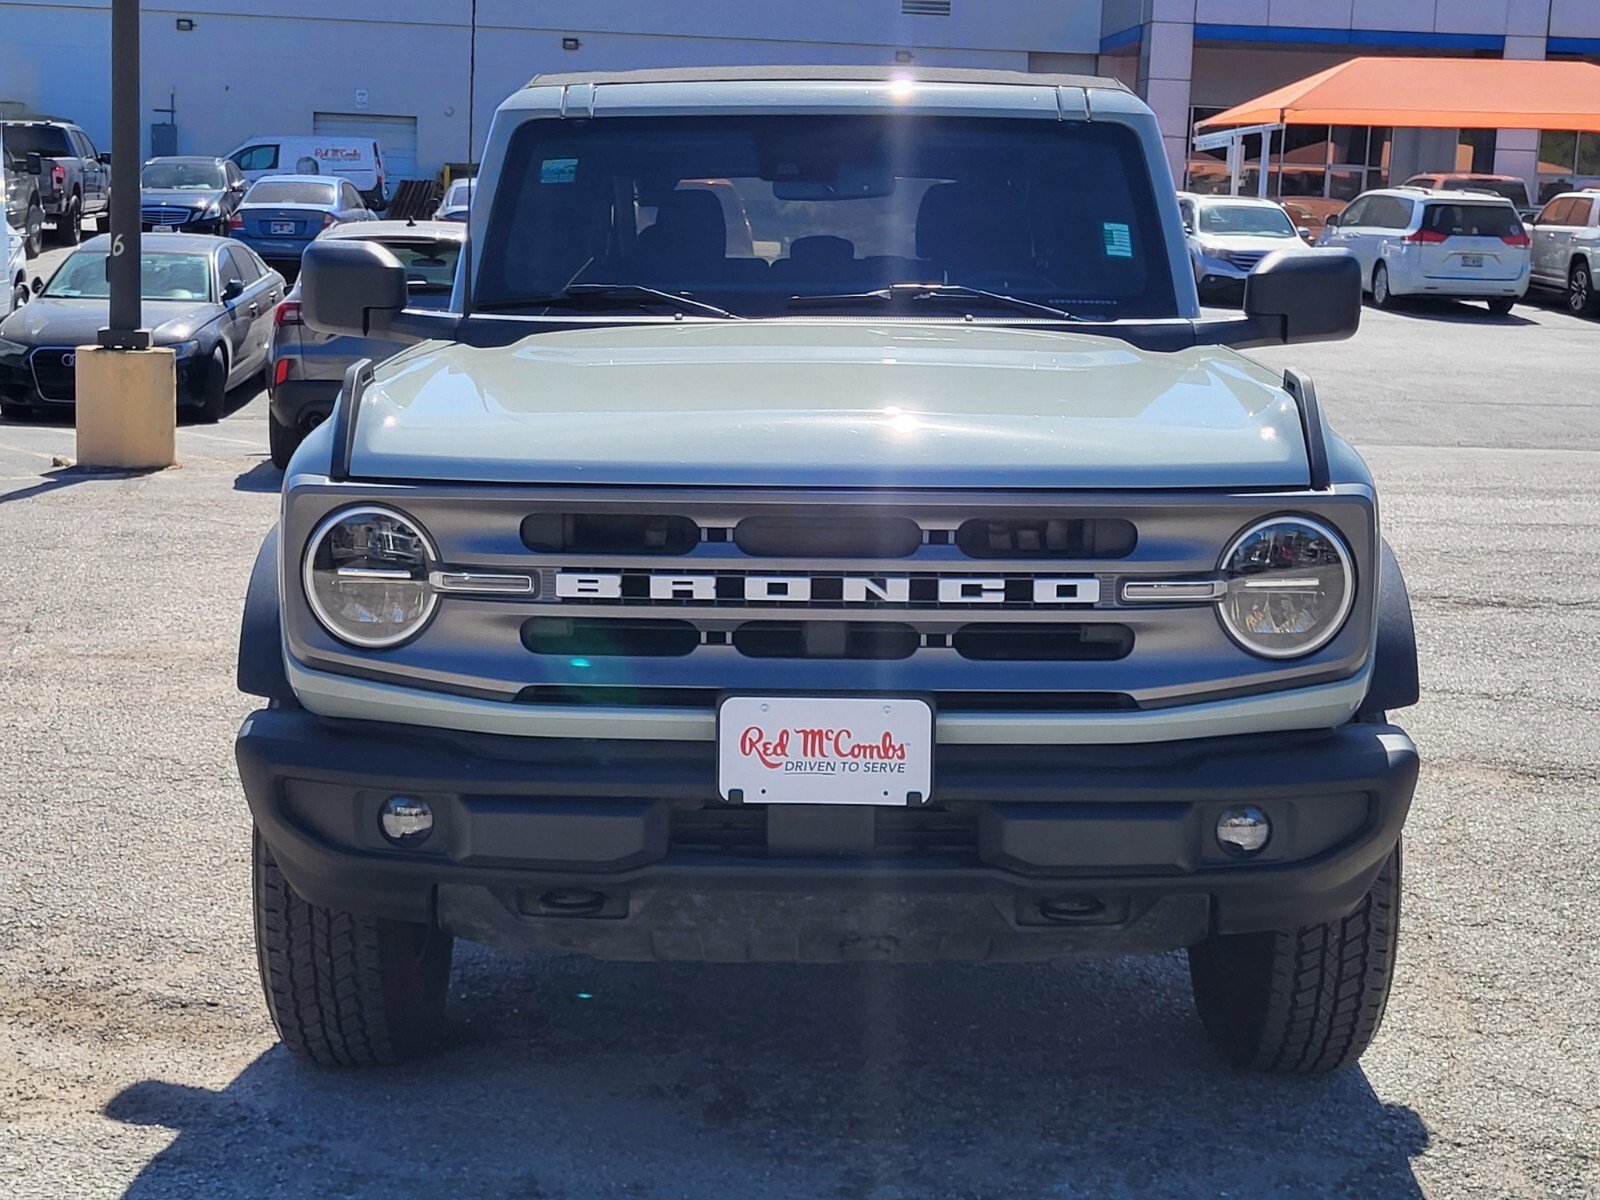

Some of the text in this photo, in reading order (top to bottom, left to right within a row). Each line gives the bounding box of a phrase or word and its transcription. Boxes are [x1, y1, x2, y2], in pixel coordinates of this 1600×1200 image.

[112, 233, 125, 257] 6
[555, 572, 1101, 604] BRONCO
[740, 726, 906, 770] Red McCombs
[784, 760, 906, 774] DRIVEN TO SERVE
